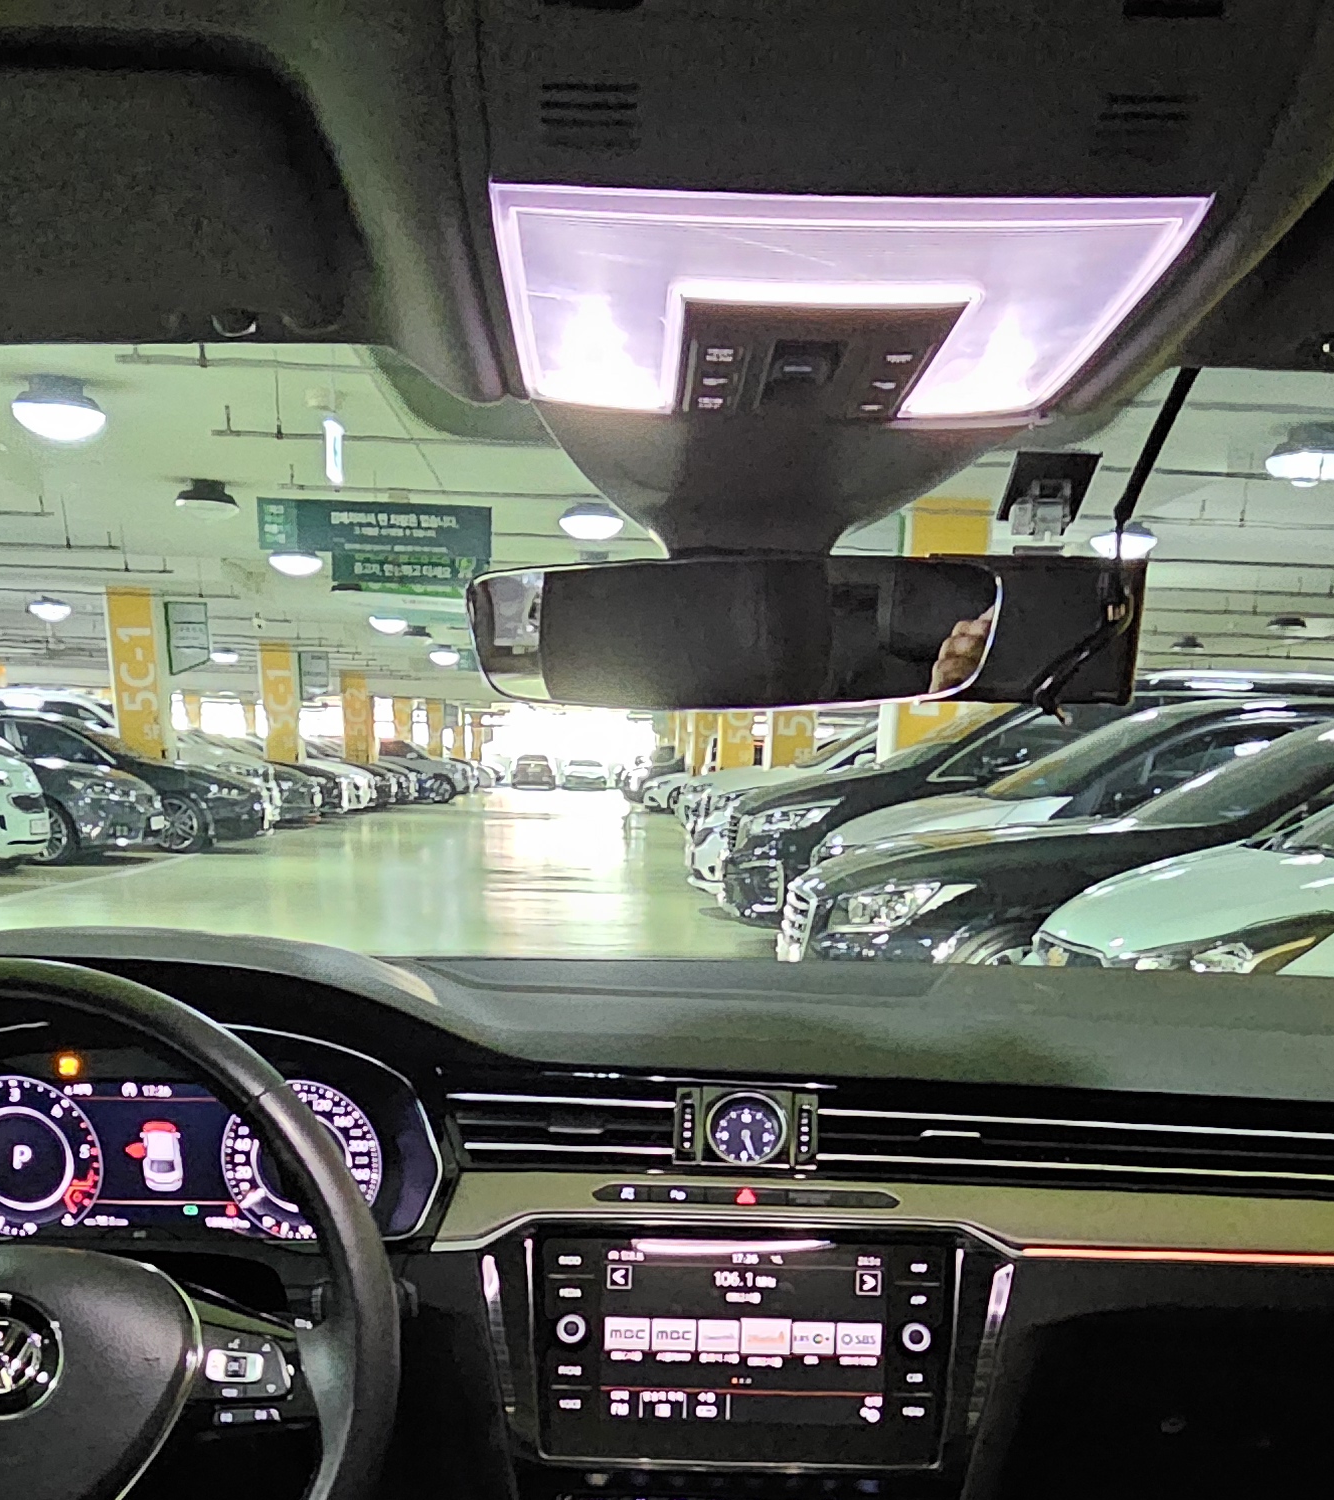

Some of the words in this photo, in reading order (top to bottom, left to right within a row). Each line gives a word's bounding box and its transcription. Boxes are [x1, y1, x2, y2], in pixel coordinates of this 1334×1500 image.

[116, 625, 159, 712] 5C-1
[12, 1144, 33, 1170] P
[713, 1270, 755, 1289] 106.1
